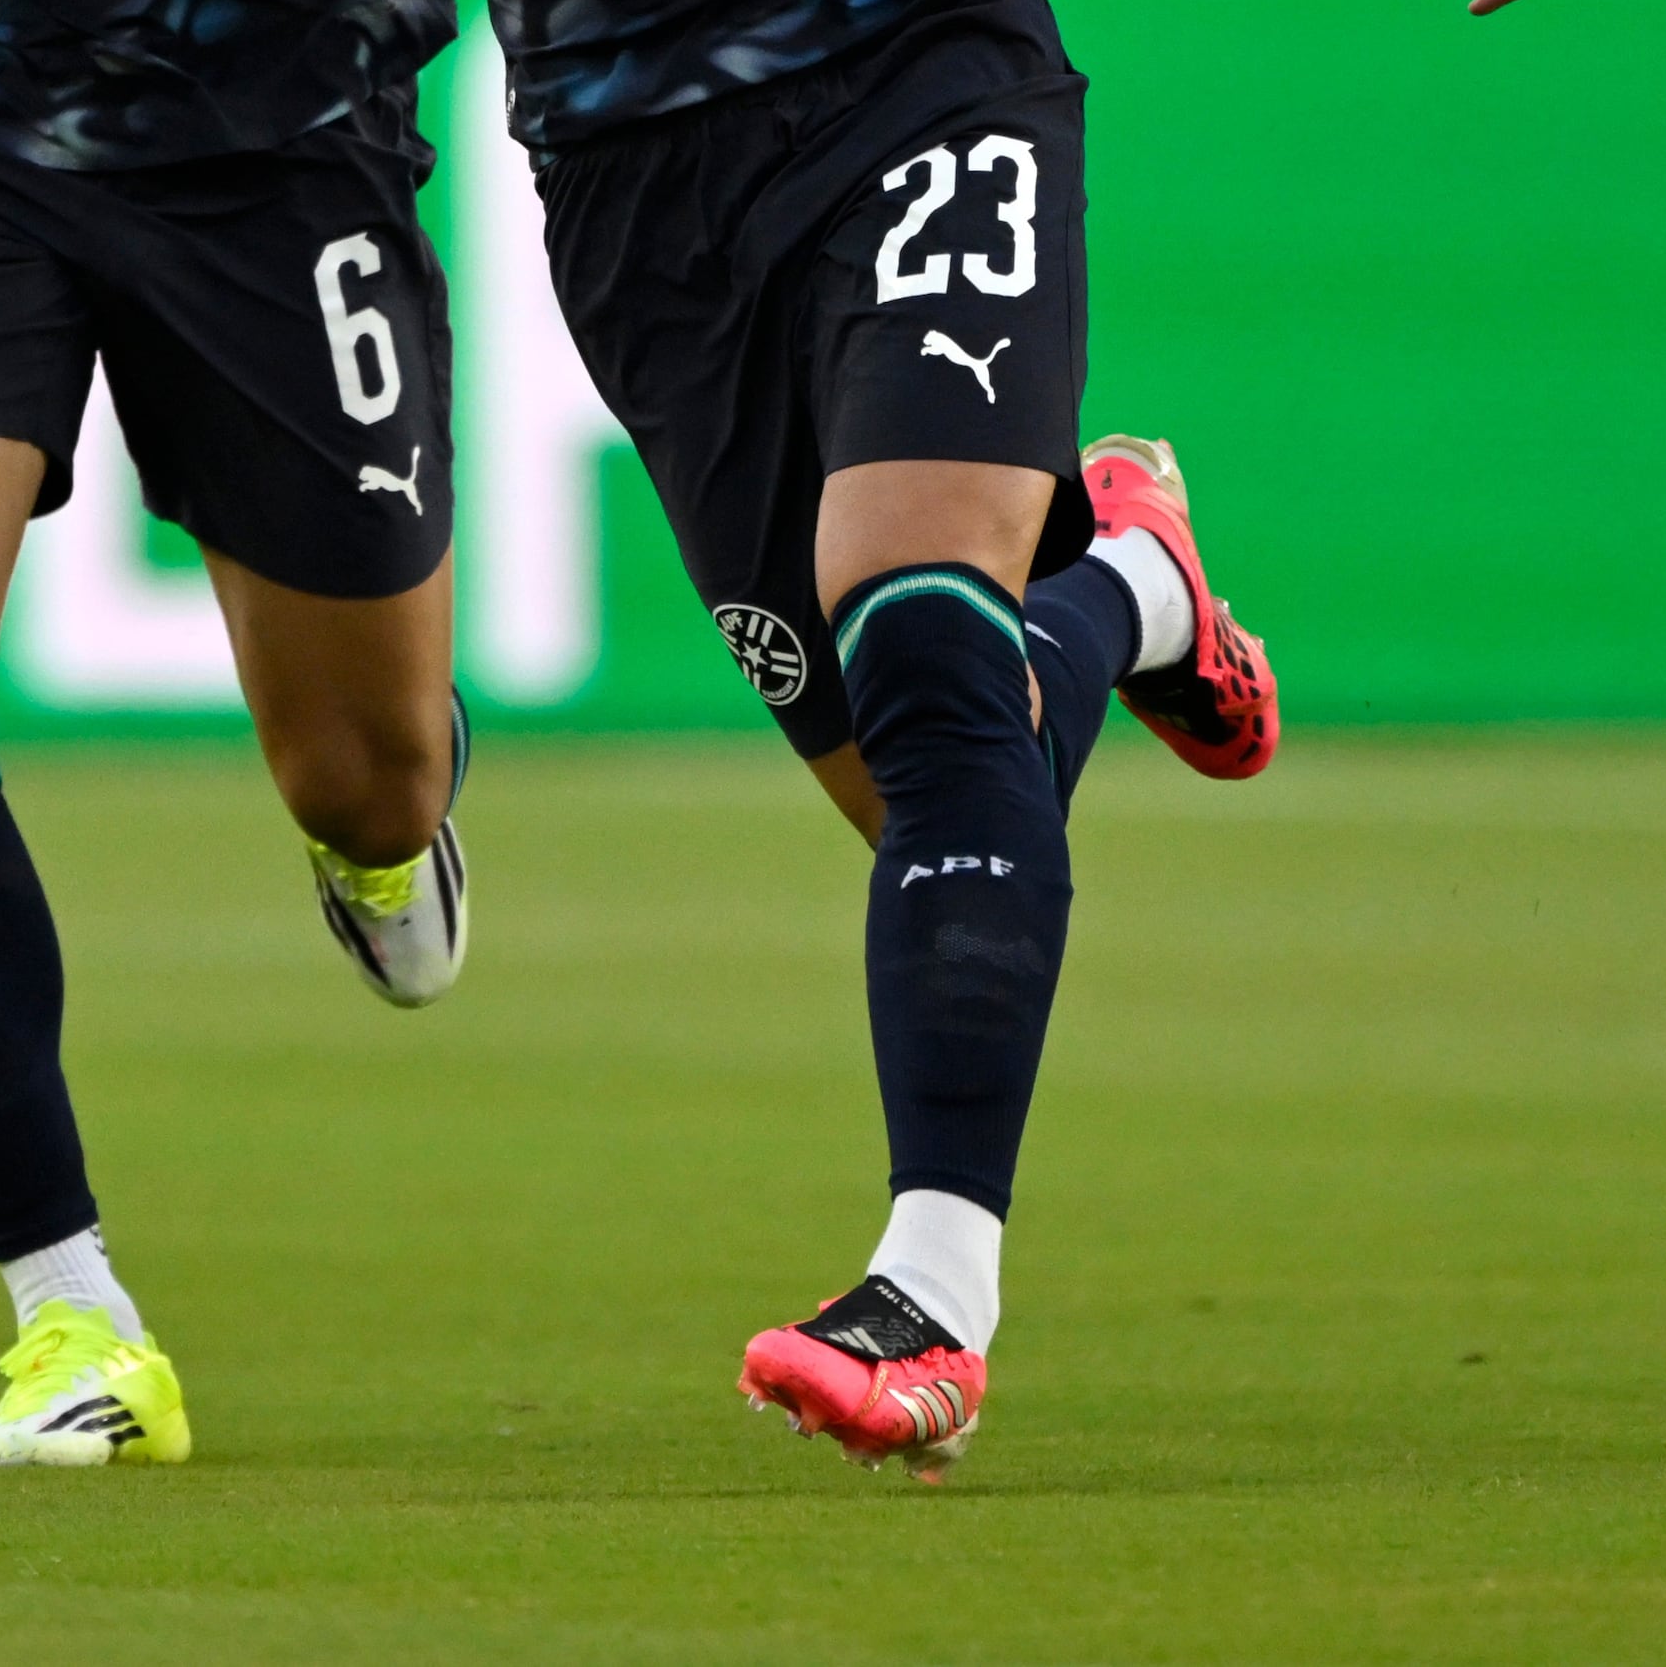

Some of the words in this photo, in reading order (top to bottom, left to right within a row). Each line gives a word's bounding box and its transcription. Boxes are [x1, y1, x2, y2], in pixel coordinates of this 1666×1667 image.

[875, 134, 1038, 306] 23
[314, 232, 401, 426] 6
[719, 611, 743, 633] APF
[901, 856, 1014, 889] APF
